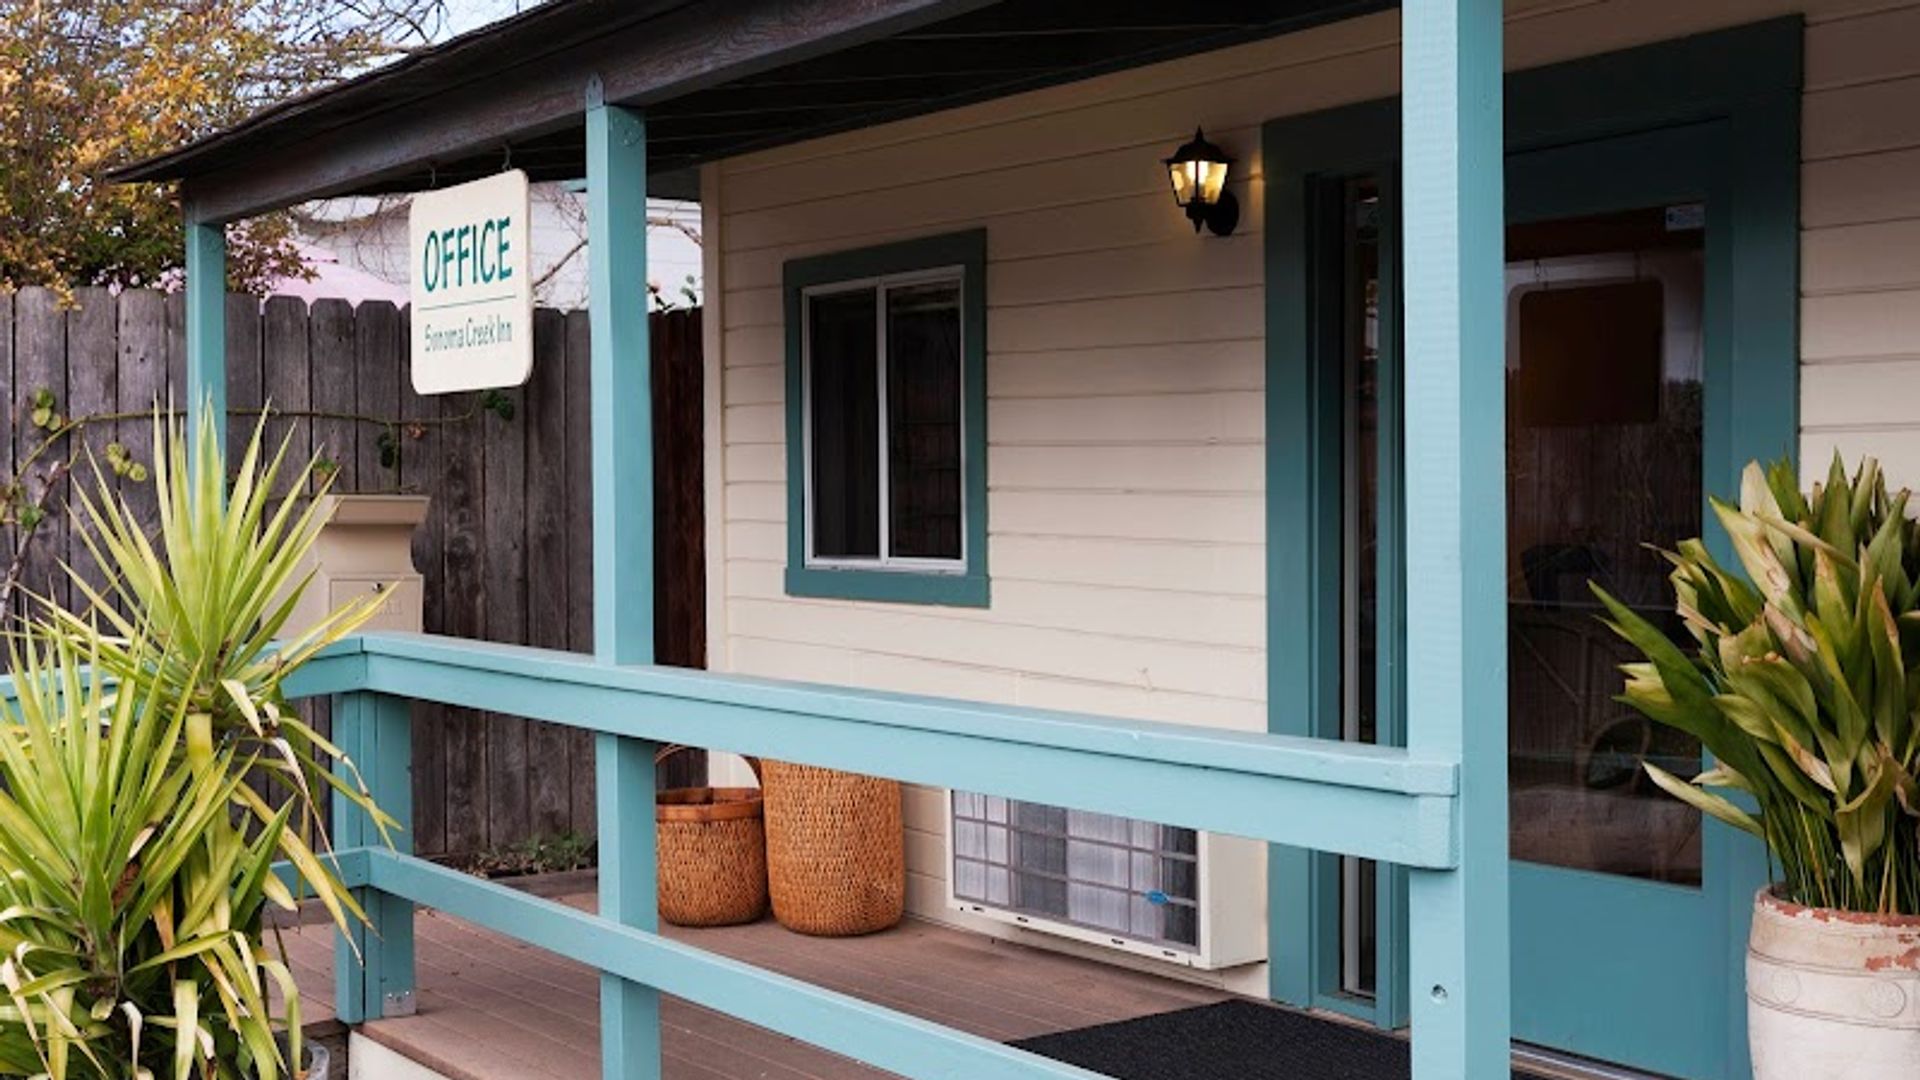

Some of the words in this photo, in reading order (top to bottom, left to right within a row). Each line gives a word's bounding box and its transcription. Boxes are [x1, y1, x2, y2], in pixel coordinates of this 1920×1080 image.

[423, 216, 513, 292] OFFICE
[425, 323, 464, 352] Sonoma
[466, 315, 495, 347] Creek
[497, 313, 512, 343] Inn
